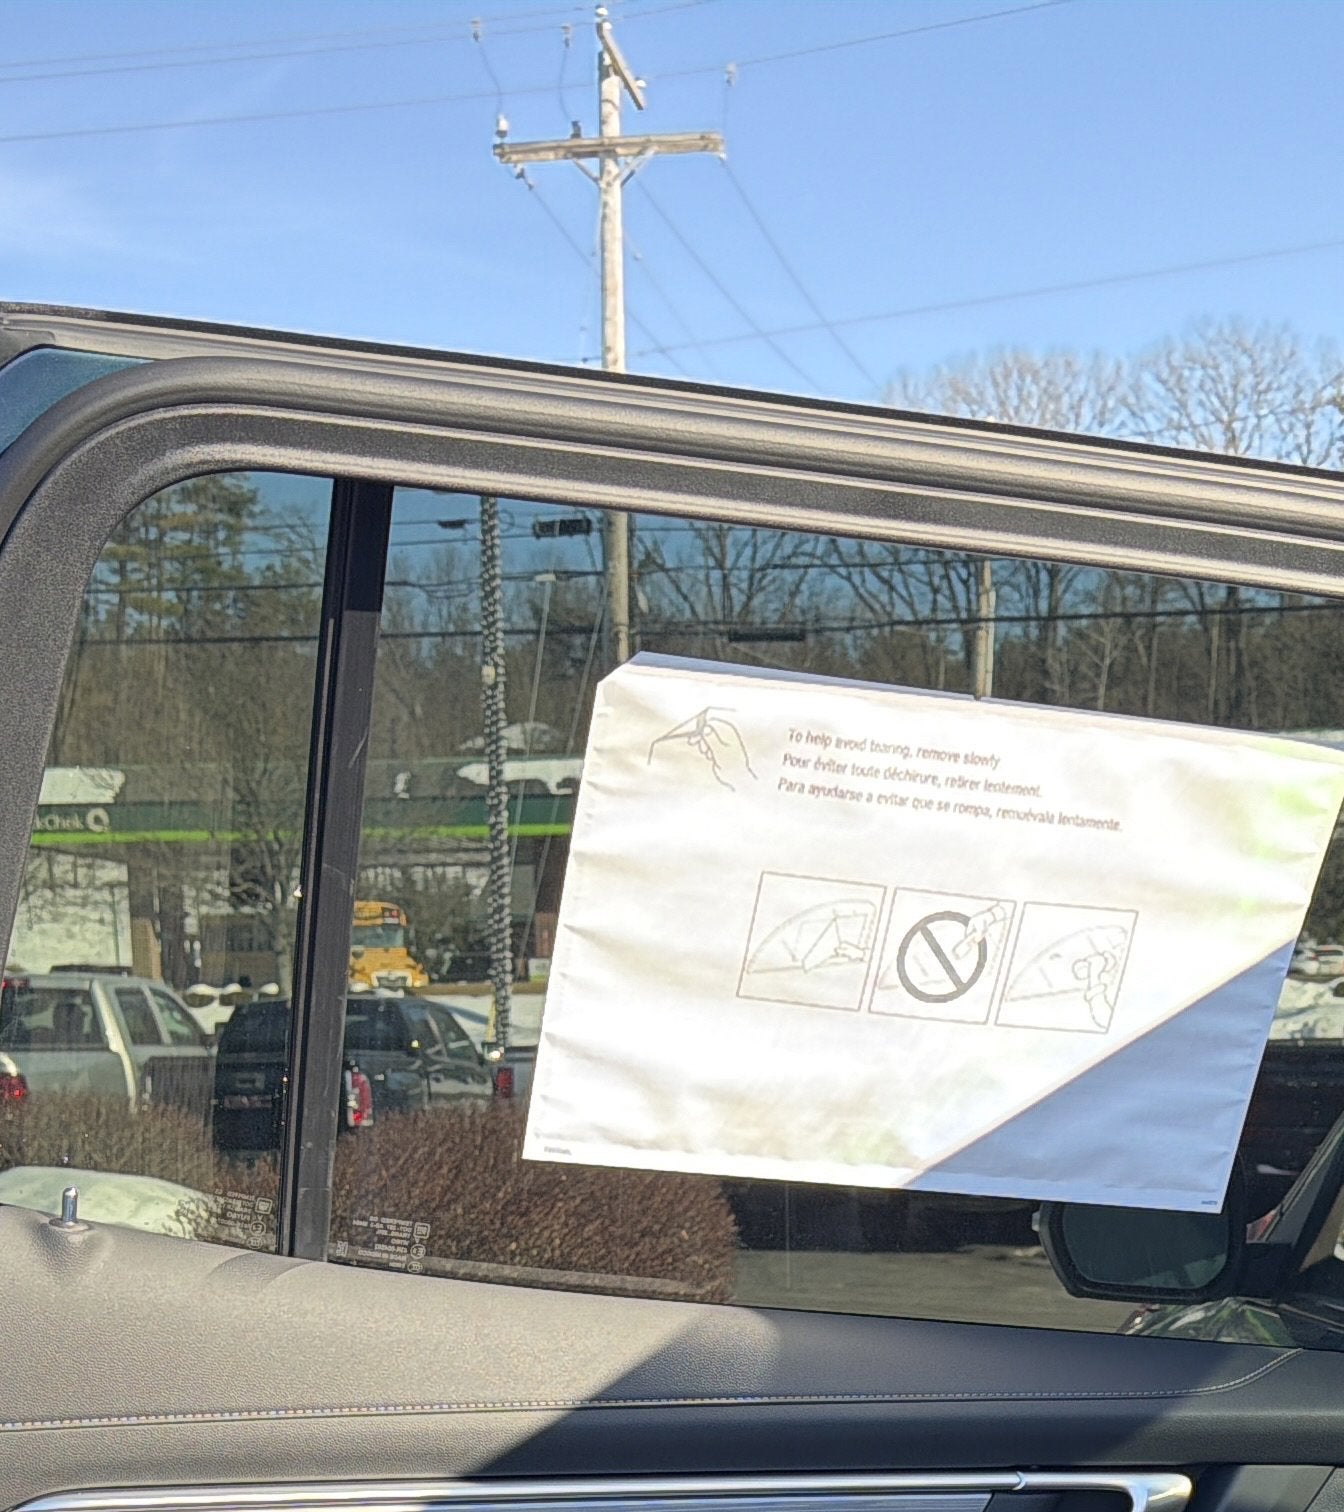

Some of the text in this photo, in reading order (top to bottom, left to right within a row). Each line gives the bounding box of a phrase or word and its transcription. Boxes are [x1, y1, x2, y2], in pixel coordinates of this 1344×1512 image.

[788, 728, 1001, 770] To help avoid tearing, remove slowly
[782, 752, 811, 768] Pour
[813, 756, 848, 775] éviter
[851, 763, 880, 779] toute
[944, 775, 981, 791] retirer
[777, 777, 805, 794] Para
[808, 783, 863, 803] ayudarse
[865, 791, 874, 803] a
[876, 792, 909, 807] evitar
[911, 797, 934, 811] que
[936, 800, 951, 812] se
